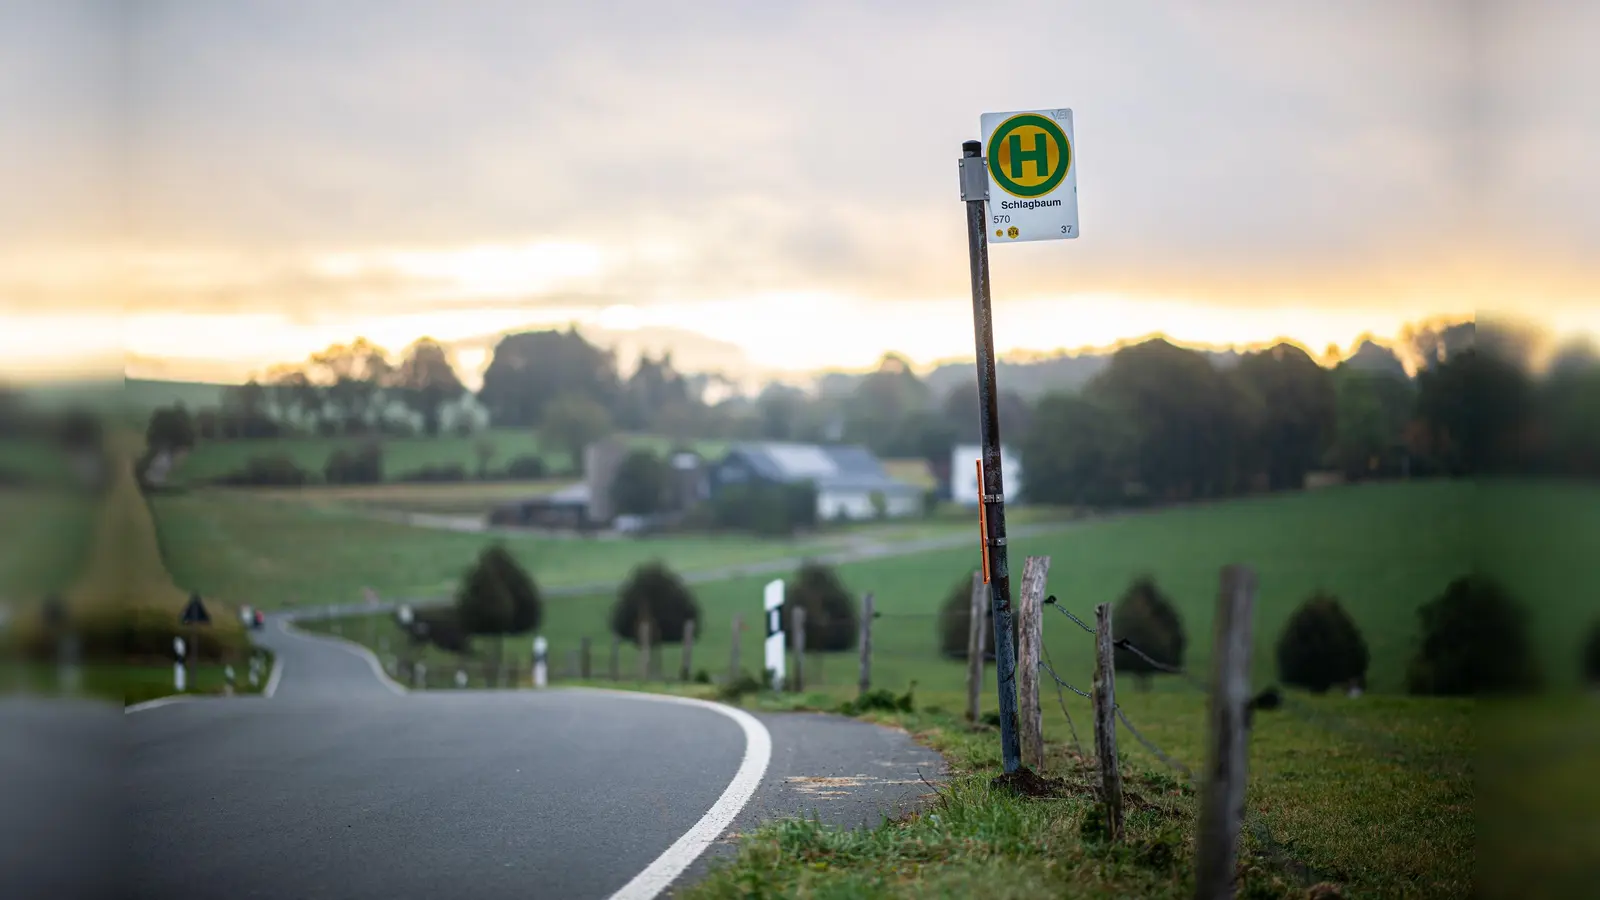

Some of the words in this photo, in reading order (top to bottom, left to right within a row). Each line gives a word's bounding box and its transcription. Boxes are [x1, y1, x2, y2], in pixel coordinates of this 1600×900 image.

[1009, 133, 1048, 178] H
[1001, 199, 1061, 210] Schlagbaum
[993, 215, 1010, 224] 570
[1060, 225, 1072, 233] 37
